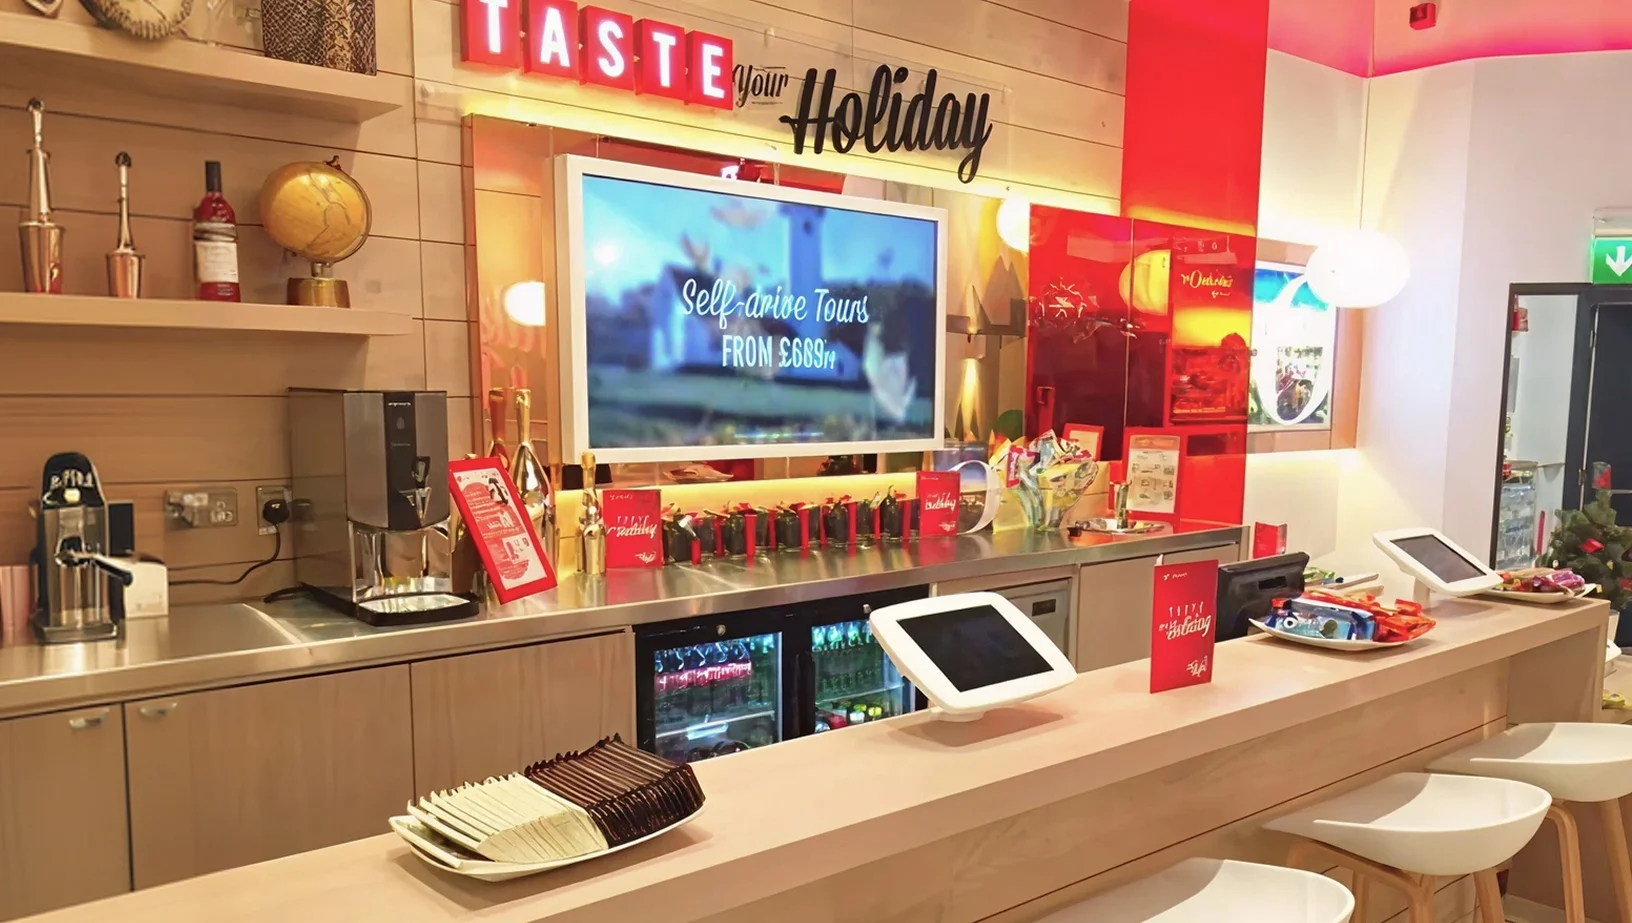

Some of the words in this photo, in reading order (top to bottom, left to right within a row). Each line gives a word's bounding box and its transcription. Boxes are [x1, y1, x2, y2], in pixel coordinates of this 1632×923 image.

[482, 0, 725, 99] TASTE
[779, 64, 993, 184] Holiday
[814, 288, 870, 324] Tours
[722, 334, 774, 367] FROM
